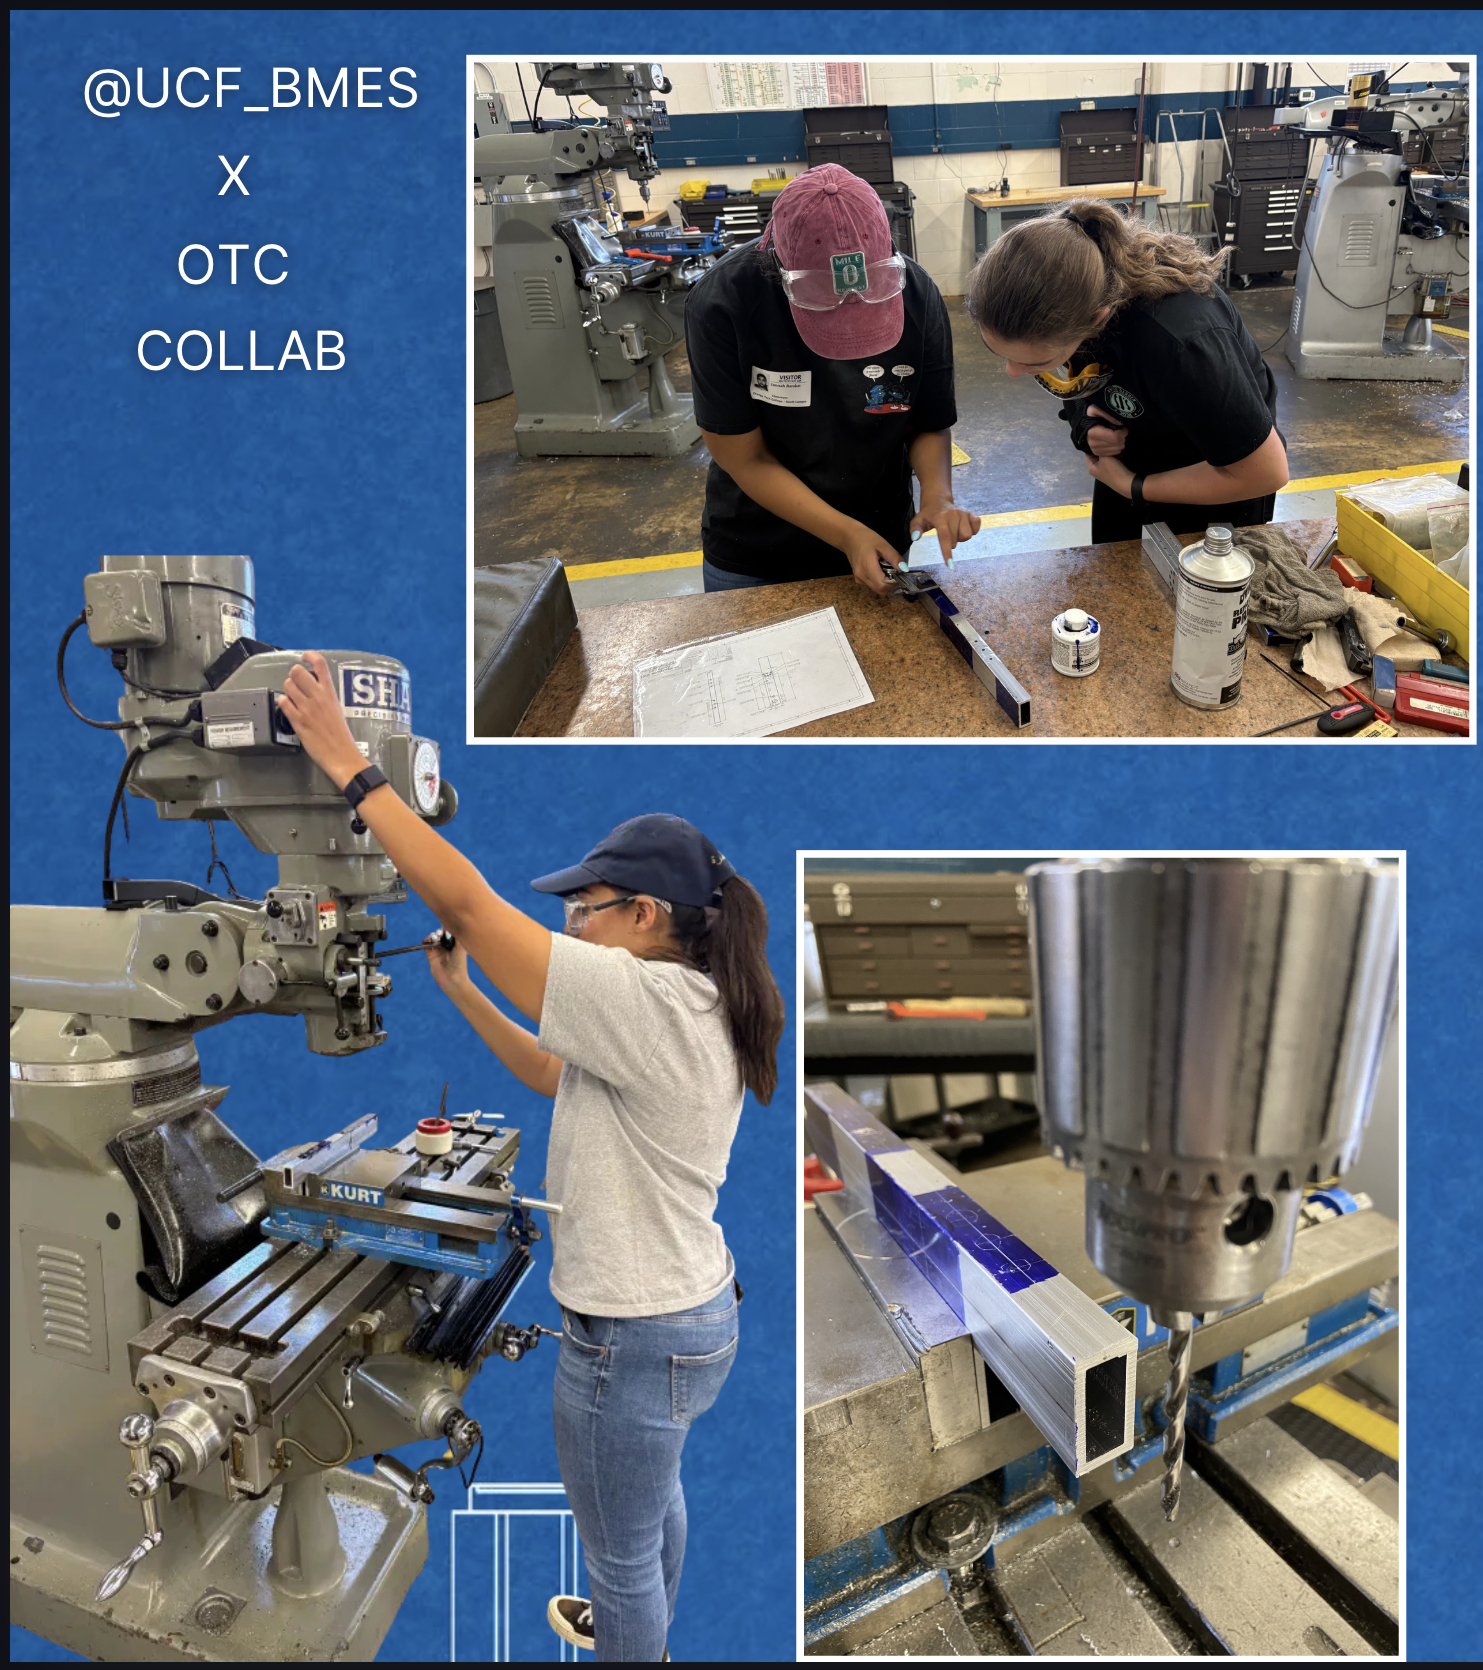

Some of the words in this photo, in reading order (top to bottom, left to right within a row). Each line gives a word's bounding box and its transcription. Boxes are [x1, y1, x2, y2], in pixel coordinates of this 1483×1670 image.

[835, 255, 860, 265] MILE
[843, 265, 858, 285] 0
[331, 1184, 382, 1204] KURT
